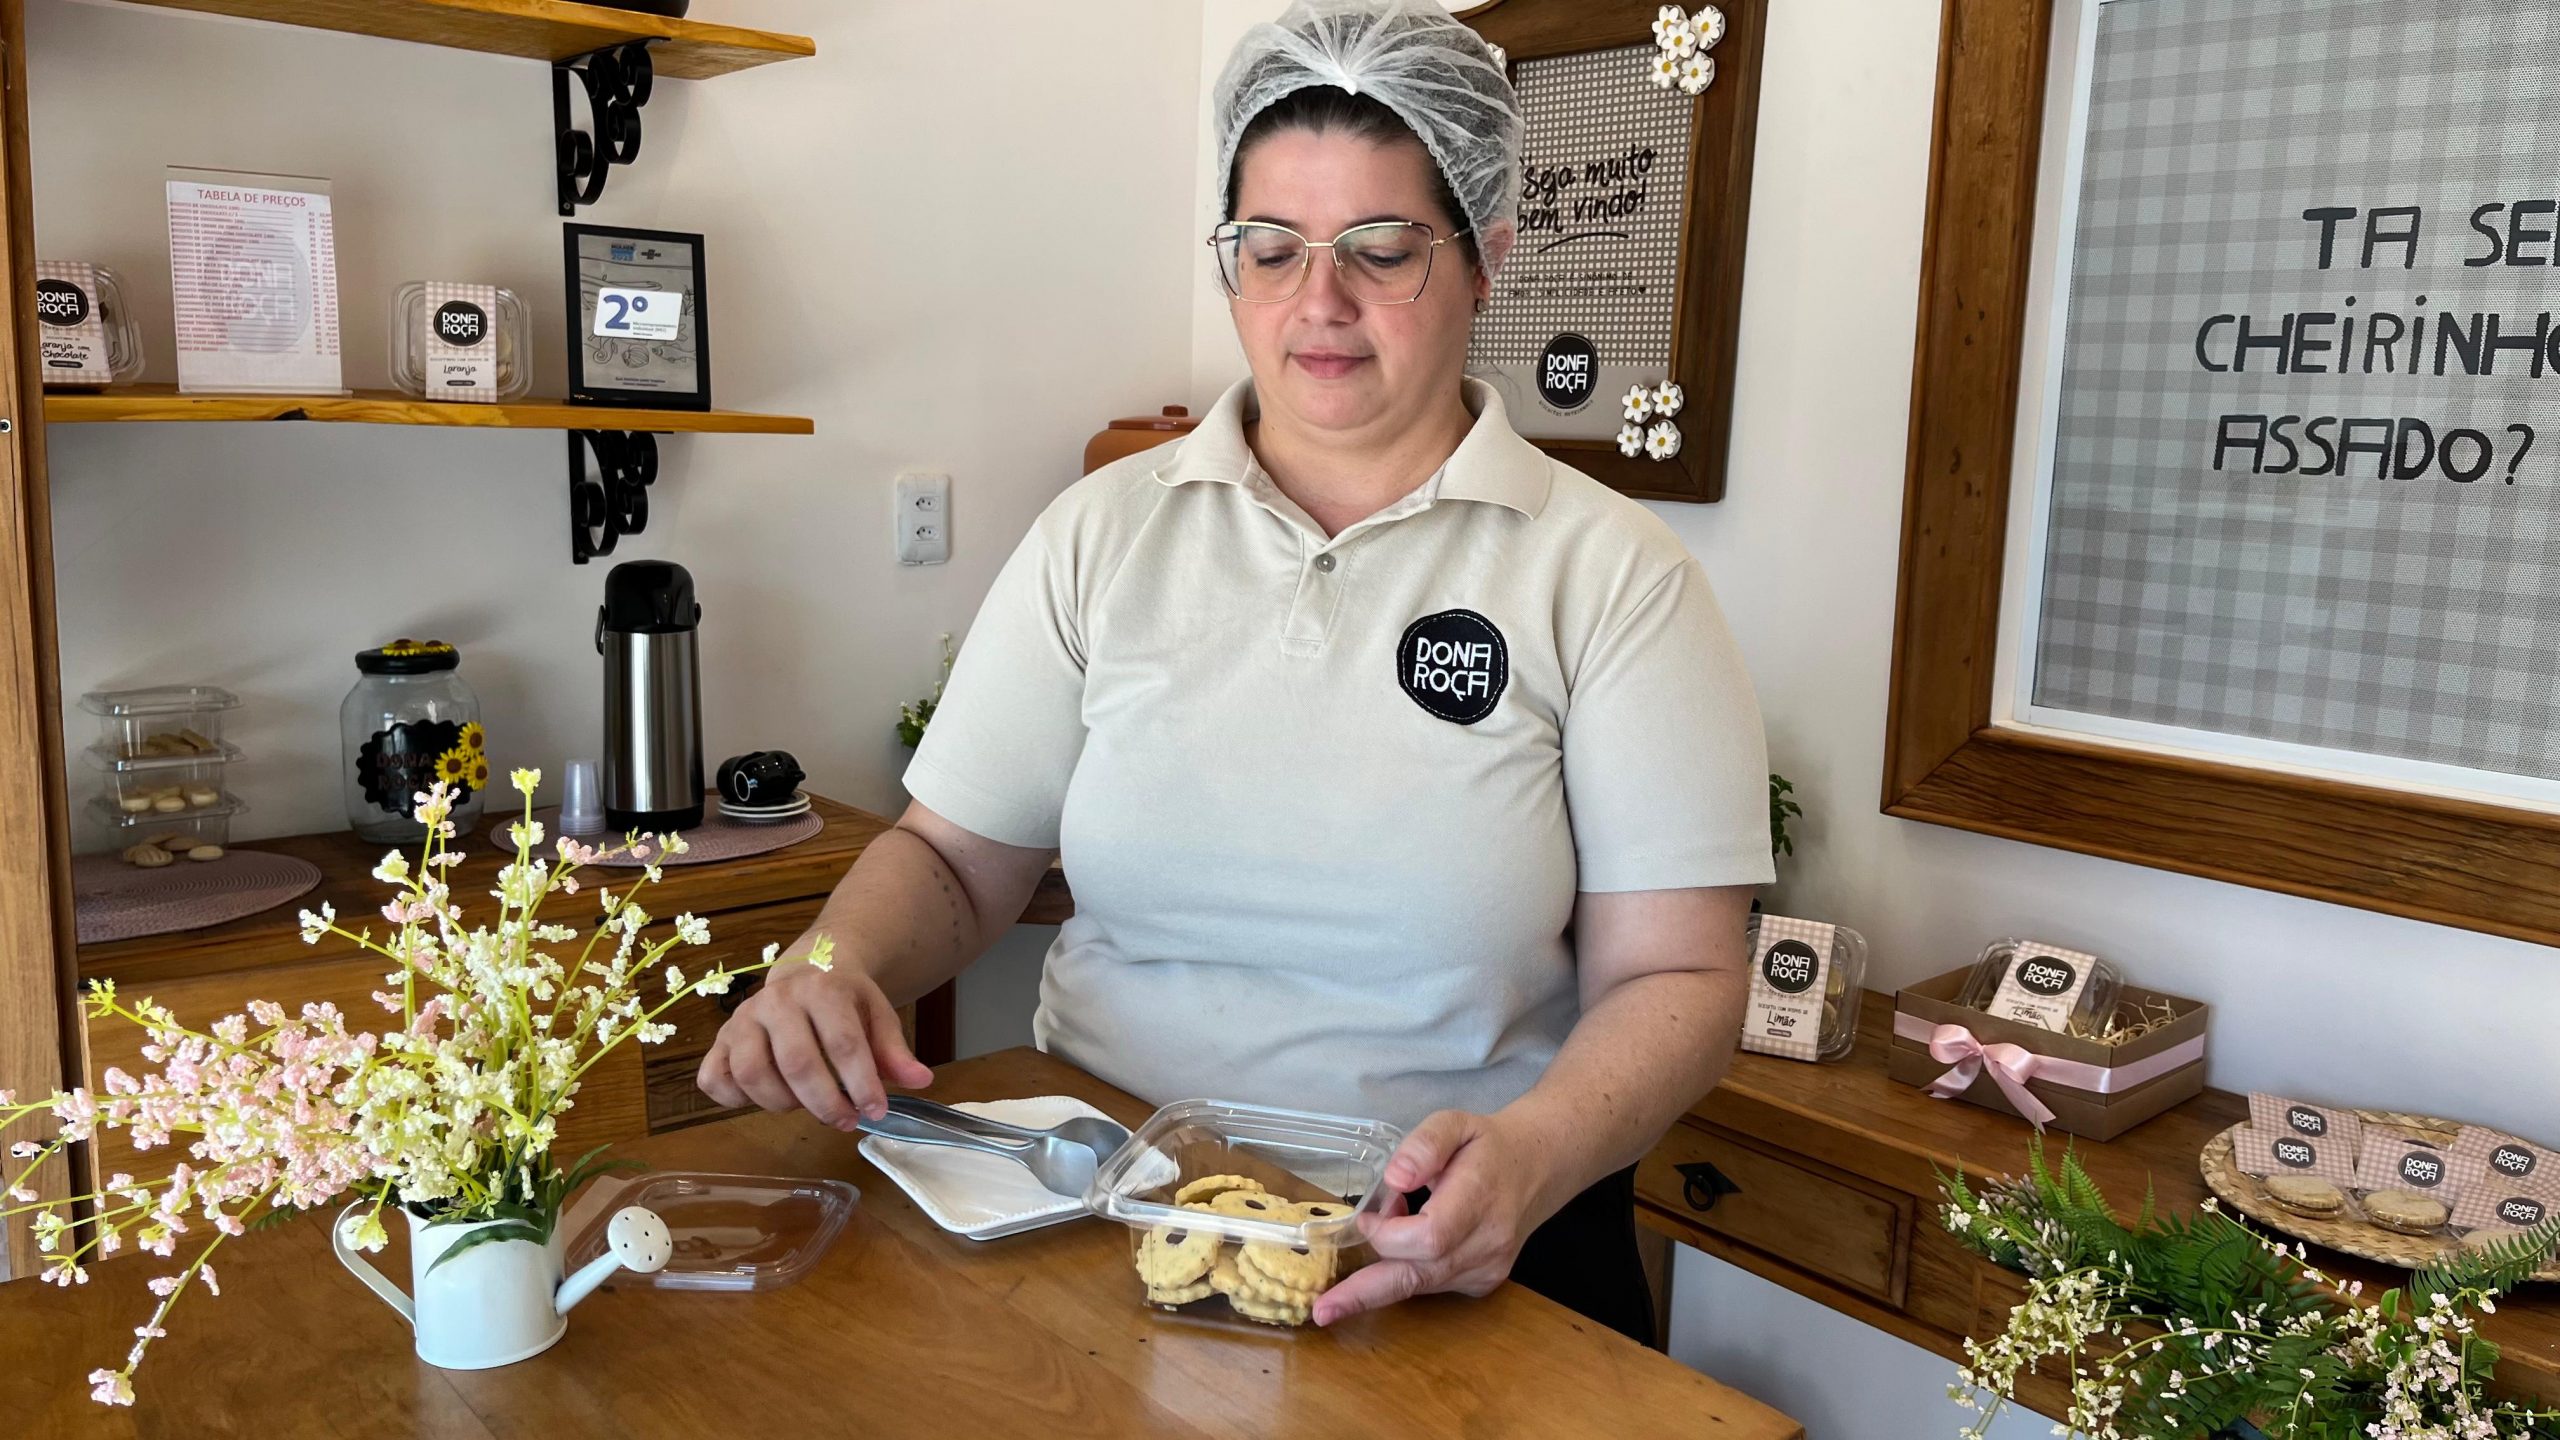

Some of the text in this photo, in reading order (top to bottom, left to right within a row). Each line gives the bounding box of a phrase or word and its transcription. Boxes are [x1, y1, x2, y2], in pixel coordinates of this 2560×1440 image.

[1585, 144, 1657, 187] muito
[197, 189, 306, 208] TABELA DE PREÇOS
[1516, 179, 1646, 233] bem vindo!
[2302, 200, 2560, 269] TA SE
[37, 303, 79, 317] ROÇA
[442, 312, 478, 325] DONA
[442, 323, 478, 338] ROÇA
[2195, 295, 2560, 379] CHEIRINH
[42, 350, 89, 360] Chocolate
[1547, 353, 1588, 371] DONA
[443, 364, 477, 376] Laranja
[1546, 371, 1587, 394] ROÇA
[2213, 414, 2536, 485] ASSADO?
[1416, 637, 1491, 670] DONA
[1413, 663, 1489, 702] ROÇA
[1773, 951, 1810, 969] DONA
[1770, 964, 1808, 983] ROÇA
[2027, 963, 2067, 980] DONA
[2024, 972, 2063, 989] ROÇA
[1767, 1010, 1796, 1027] Limão
[2292, 1110, 2320, 1123] DONA
[2278, 1143, 2308, 1155] DONA
[2498, 1149, 2530, 1164] DONA
[2406, 1157, 2438, 1172] DONA
[2495, 1157, 2527, 1173] ROÇA
[2404, 1167, 2437, 1181] ROÇA
[2502, 1209, 2536, 1221] ROÇA
[2505, 1202, 2538, 1214] DONA
